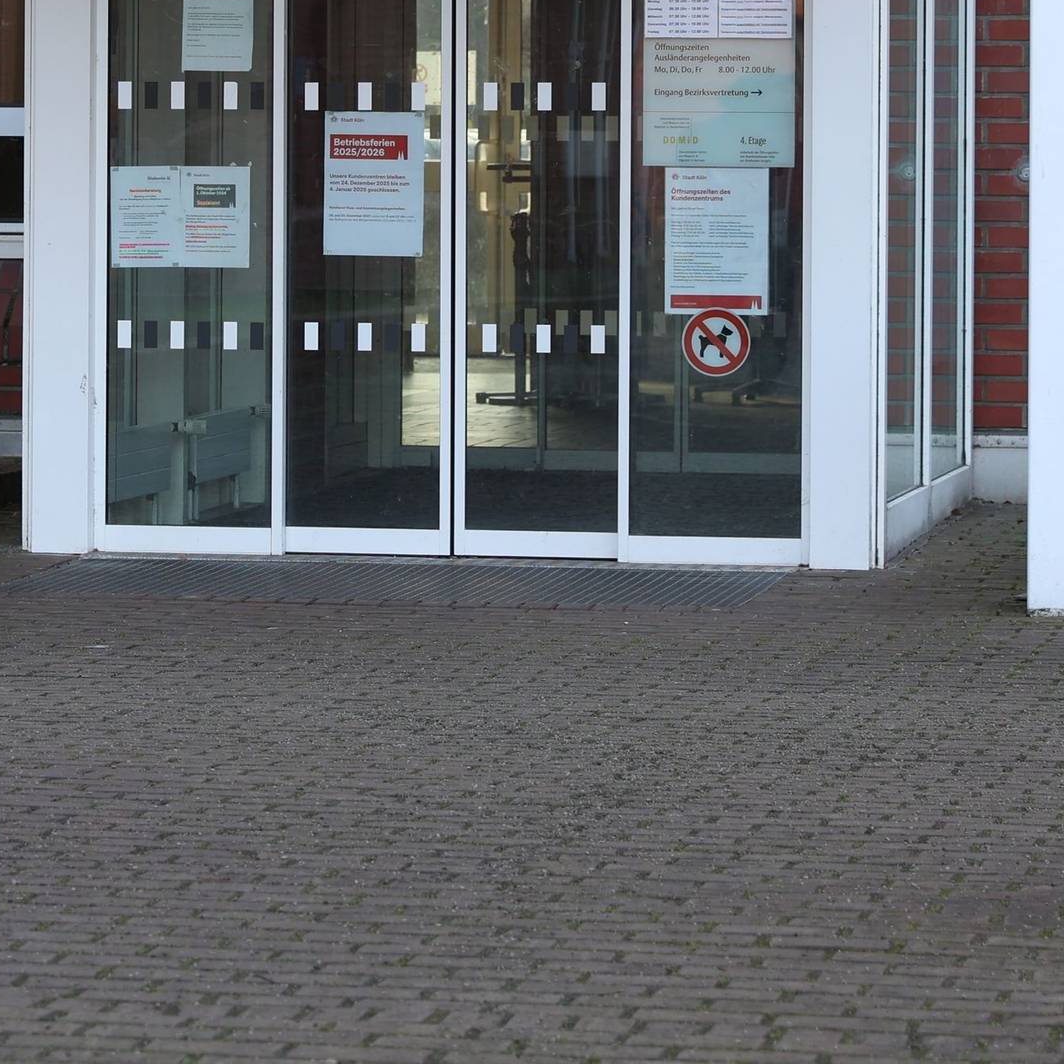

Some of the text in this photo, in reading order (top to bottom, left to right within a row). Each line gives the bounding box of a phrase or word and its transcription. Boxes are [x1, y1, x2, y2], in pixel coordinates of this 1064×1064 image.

[654, 41, 710, 51] Öffnungszeiten
[654, 53, 750, 62] Ausländerangelegenheiten
[654, 66, 668, 74] Mo,
[670, 66, 680, 74] Di,
[681, 66, 694, 74] Do,
[654, 89, 749, 98] Eingang Bezirksvertretung
[333, 138, 396, 147] Betriebsferien
[748, 136, 767, 146] Etage
[333, 147, 385, 157] 2025/2026
[671, 187, 719, 196] Öffnungszeiten
